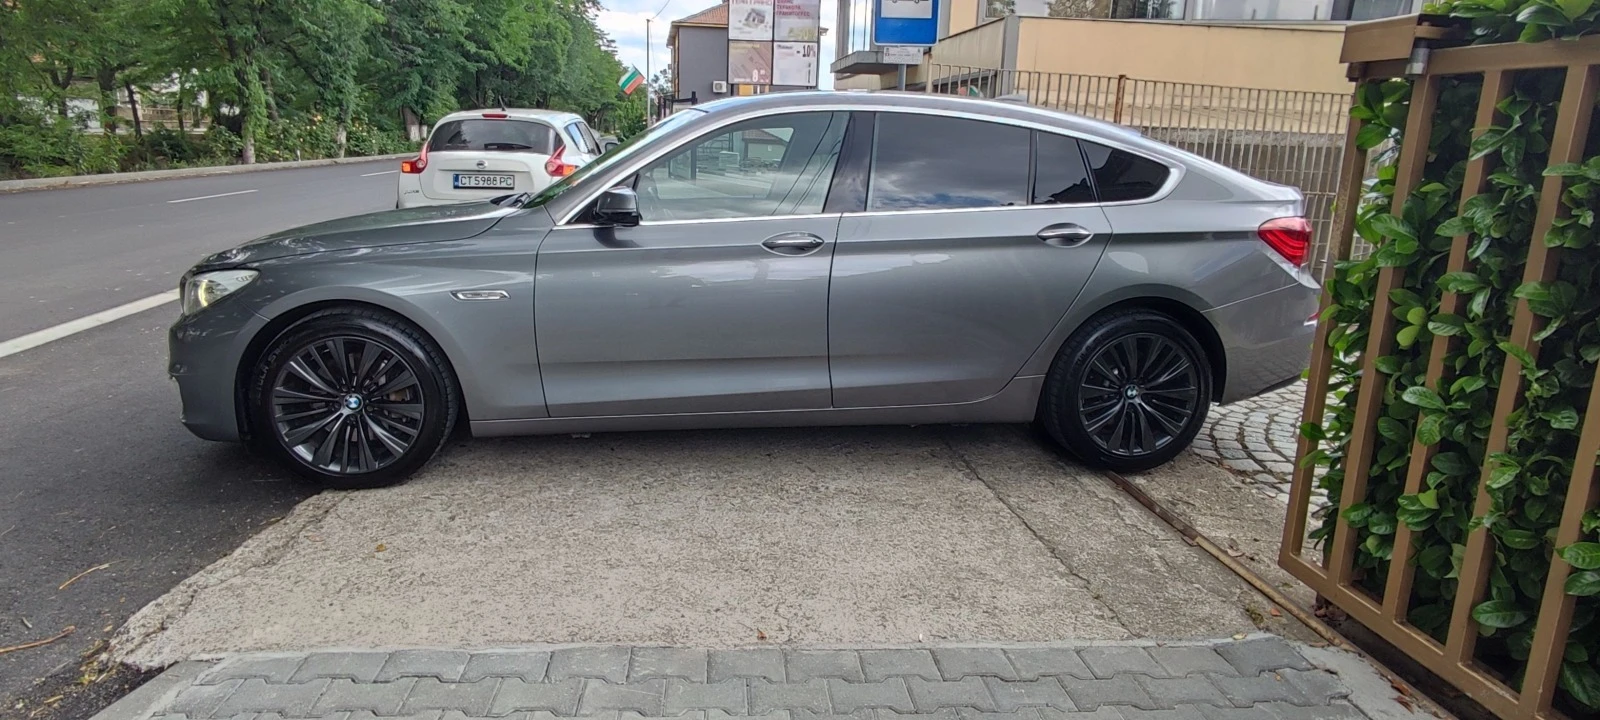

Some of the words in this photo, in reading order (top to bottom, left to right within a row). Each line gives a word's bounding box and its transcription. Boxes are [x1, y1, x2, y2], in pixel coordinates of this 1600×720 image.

[460, 176, 472, 185] CT
[474, 176, 498, 186] 5988
[499, 177, 512, 186] PC
